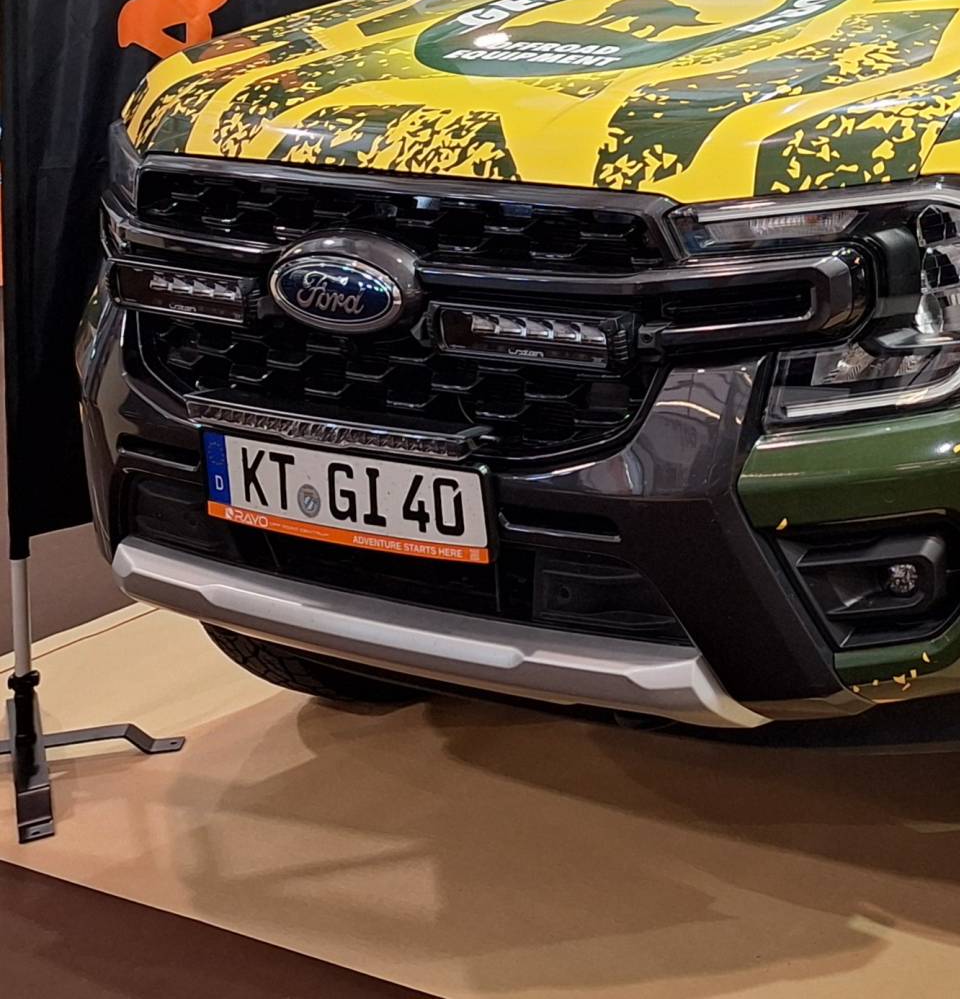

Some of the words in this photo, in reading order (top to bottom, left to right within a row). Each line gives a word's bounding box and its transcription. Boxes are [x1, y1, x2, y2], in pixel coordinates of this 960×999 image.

[443, 50, 623, 67] EQUIPMENT
[296, 270, 365, 315] Ford
[215, 475, 224, 491] D
[241, 447, 295, 510] KT
[327, 462, 387, 527] GI
[402, 474, 465, 537] 40
[352, 535, 402, 551] ADVENTURE
[403, 542, 437, 556] STARTS
[438, 548, 464, 559] HERE
